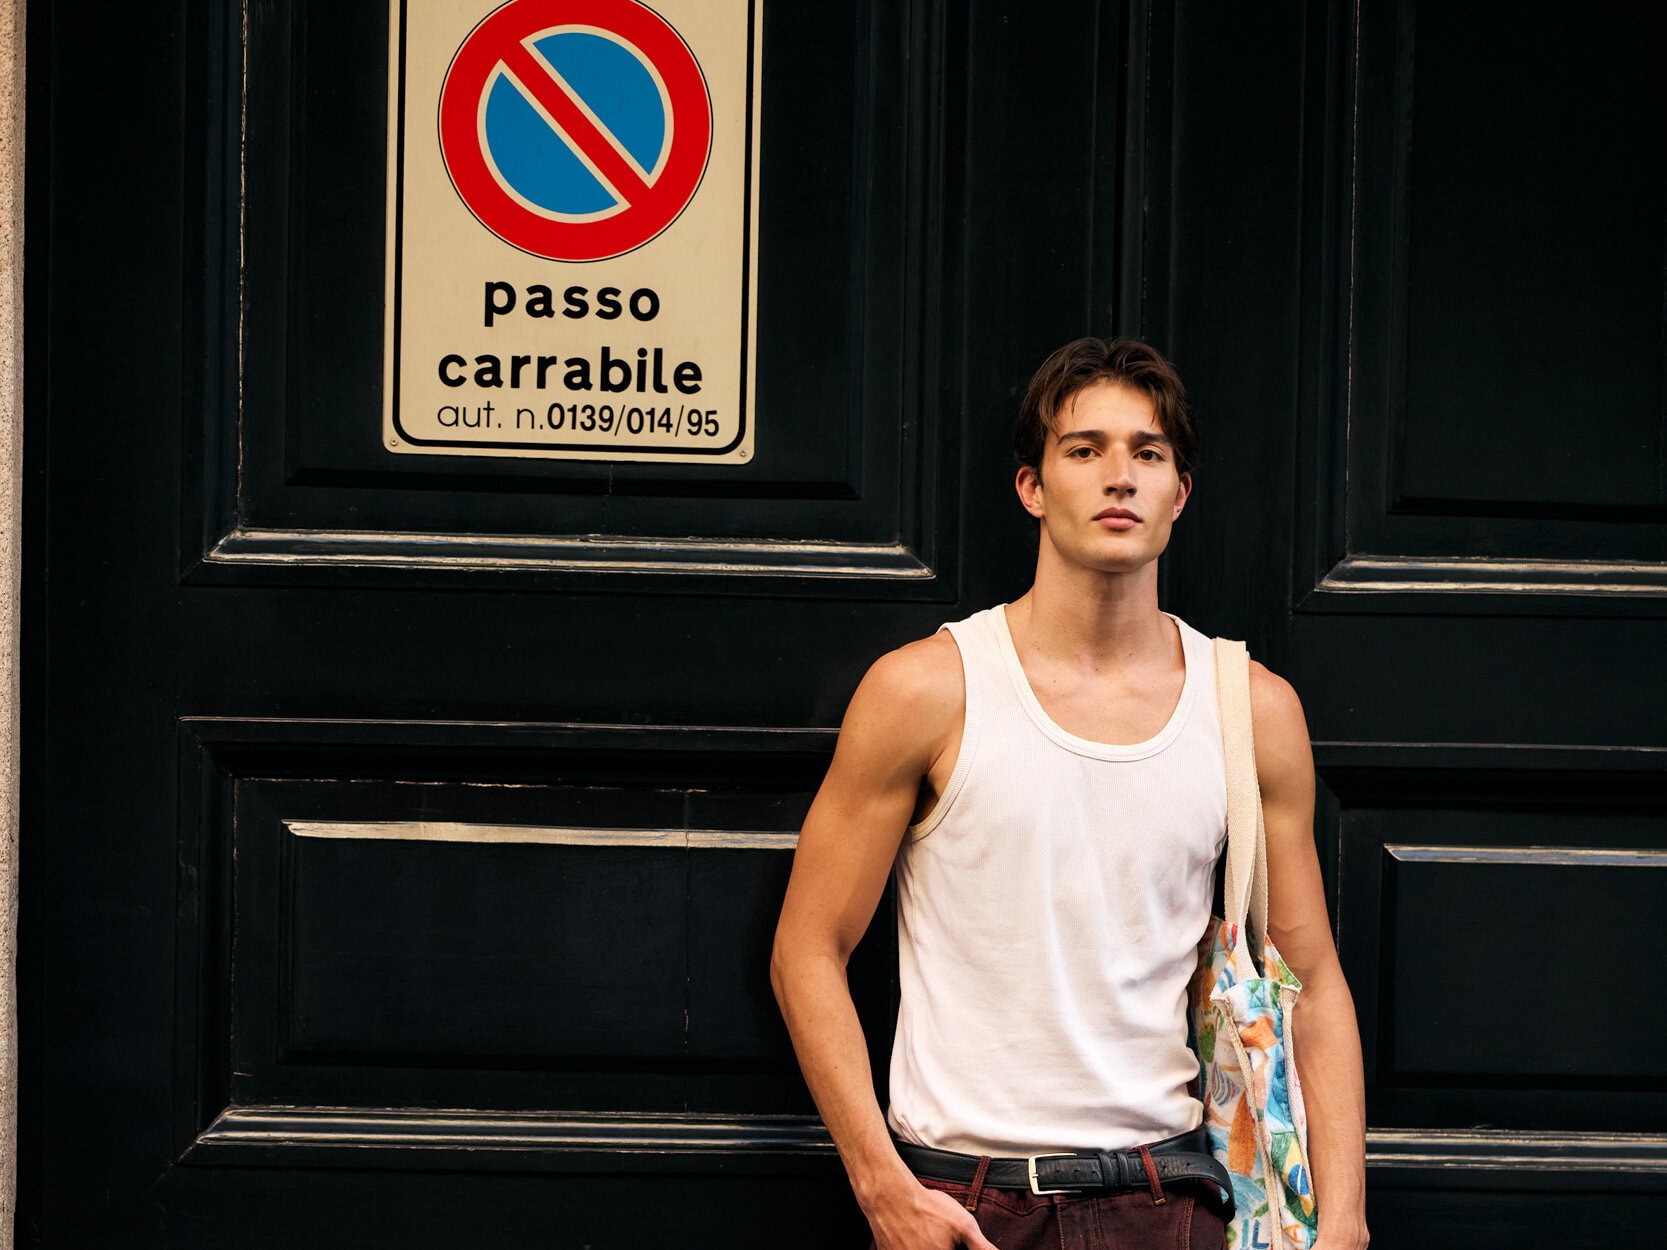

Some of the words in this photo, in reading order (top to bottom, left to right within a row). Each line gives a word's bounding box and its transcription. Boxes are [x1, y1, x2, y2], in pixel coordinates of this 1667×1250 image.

[484, 281, 660, 328] passo
[438, 346, 703, 395] carrabile
[437, 400, 502, 429] aut.
